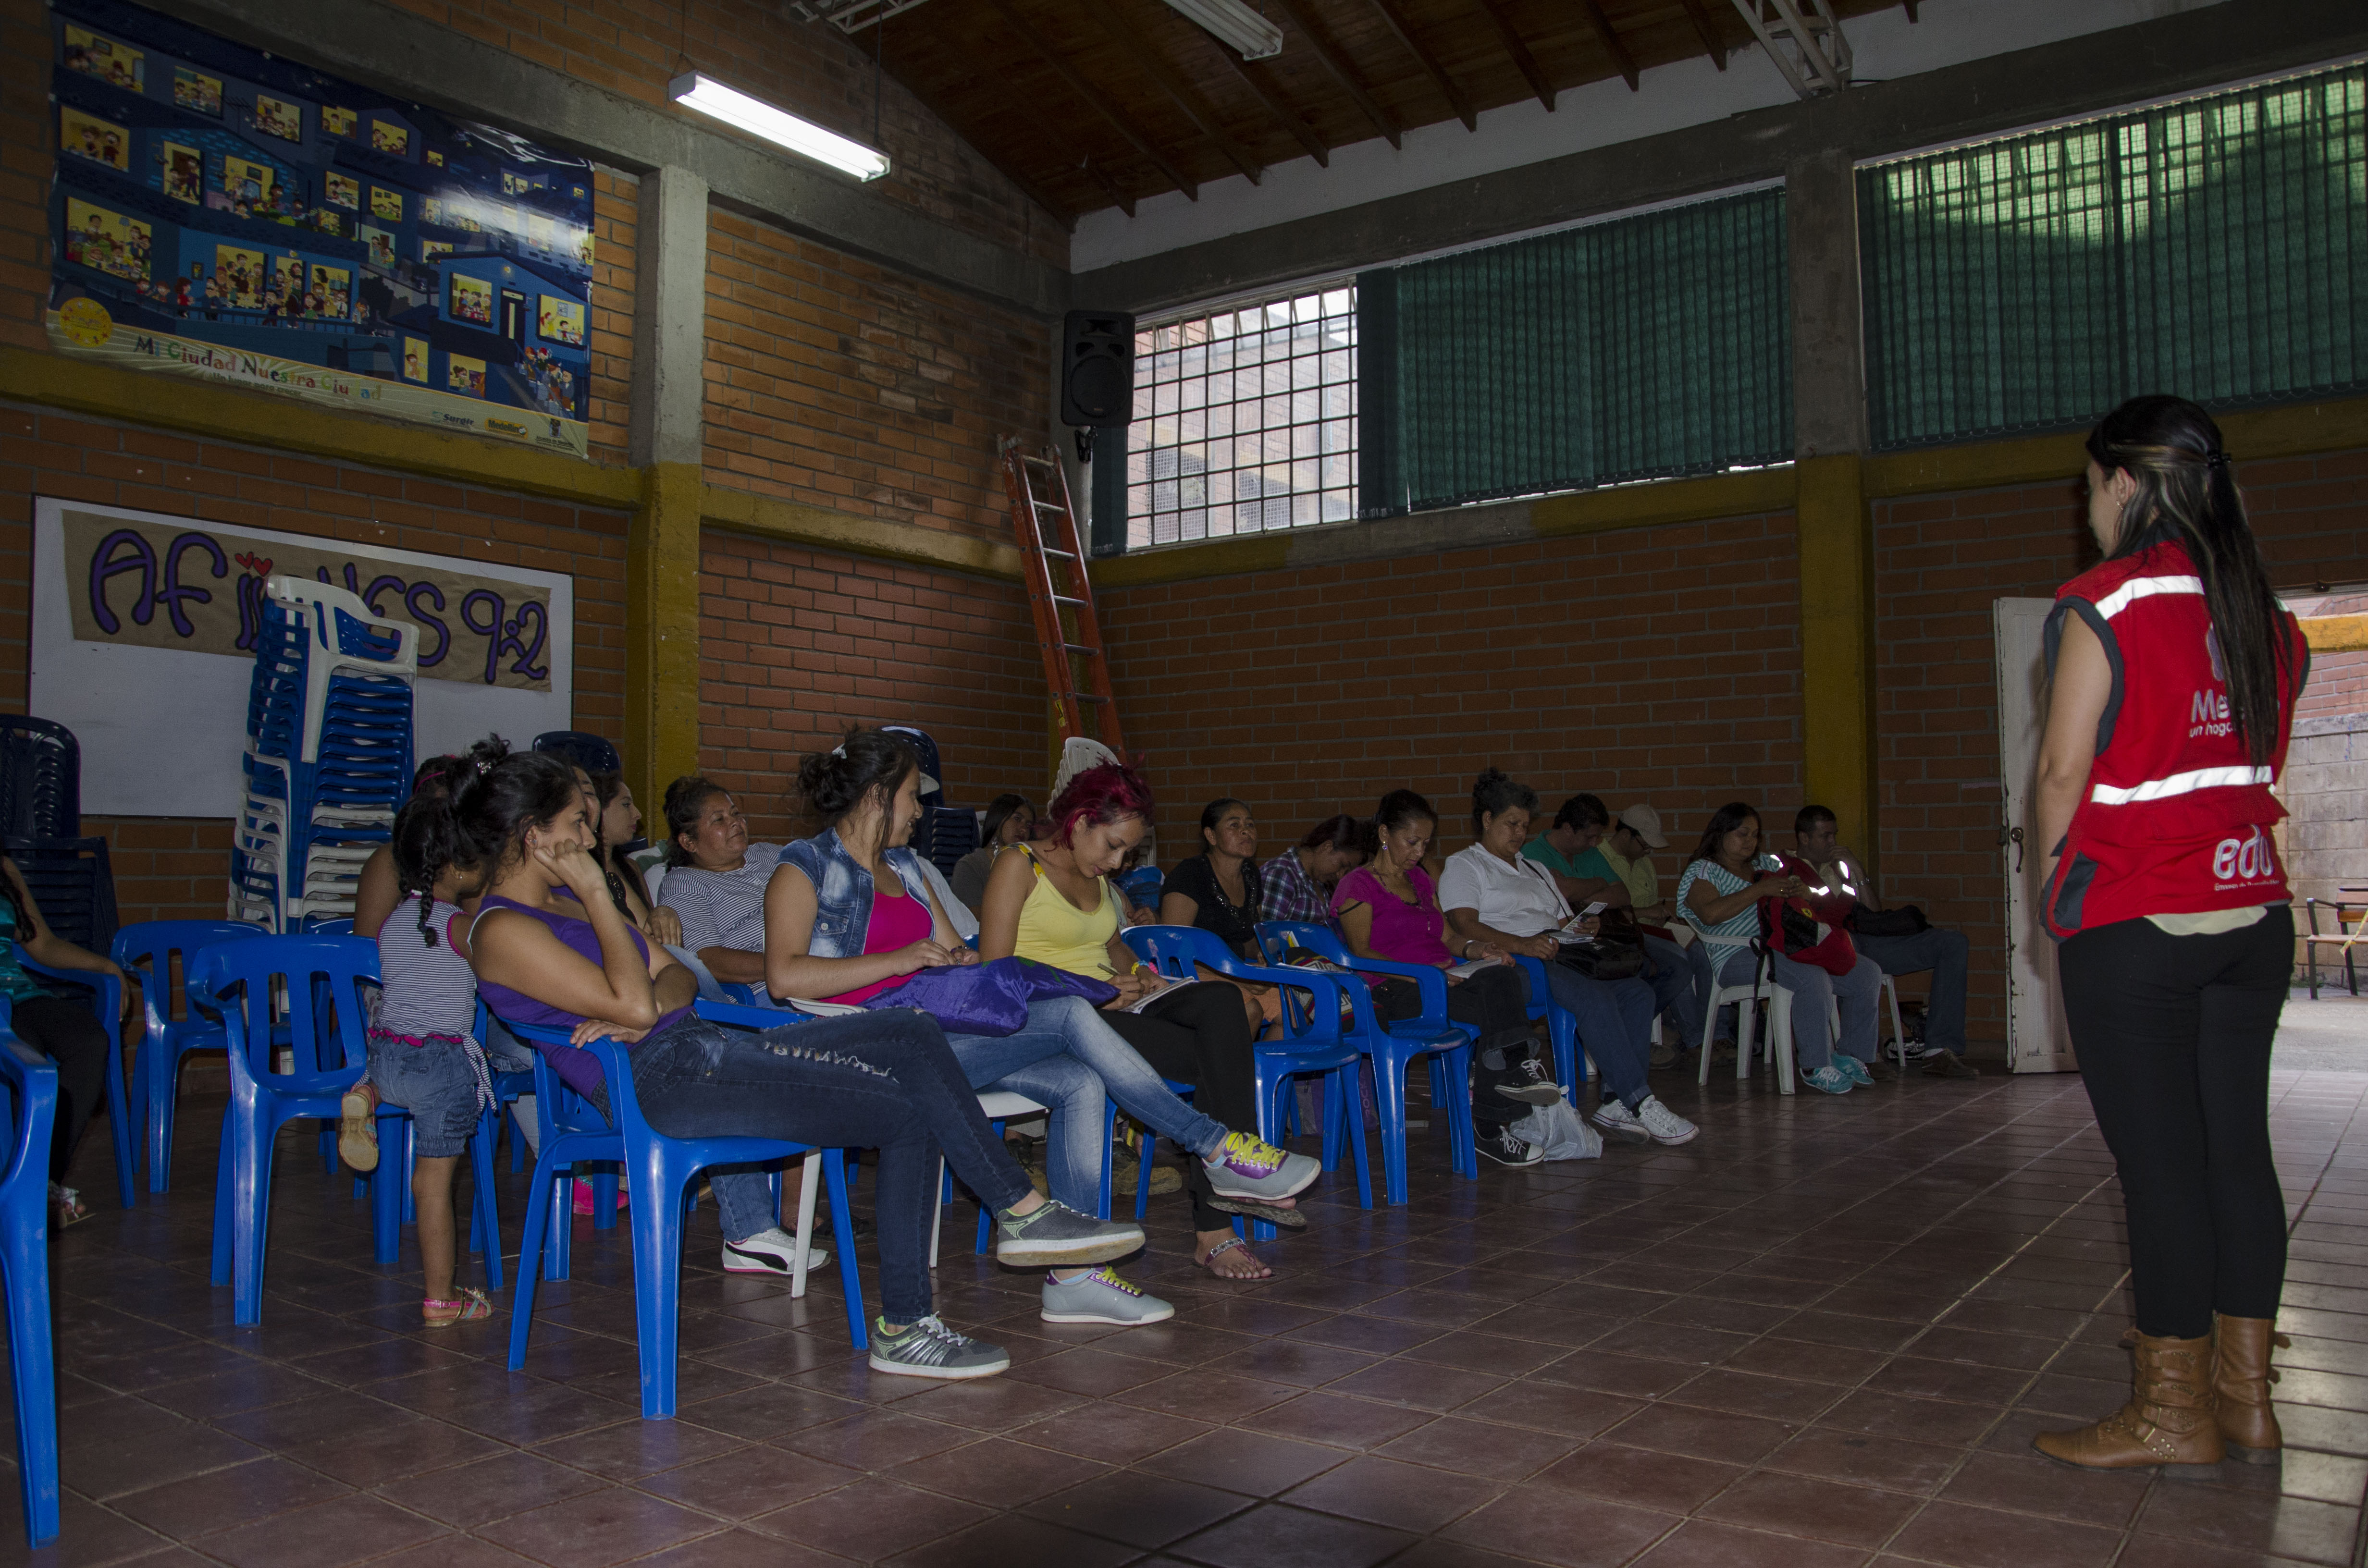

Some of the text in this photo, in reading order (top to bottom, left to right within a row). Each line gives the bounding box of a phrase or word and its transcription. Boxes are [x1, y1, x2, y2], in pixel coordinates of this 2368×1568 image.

[134, 336, 381, 400] Mi Ciudad Nuestra Ciudad
[443, 414, 474, 426] Surgir
[2189, 725, 2203, 738] un
